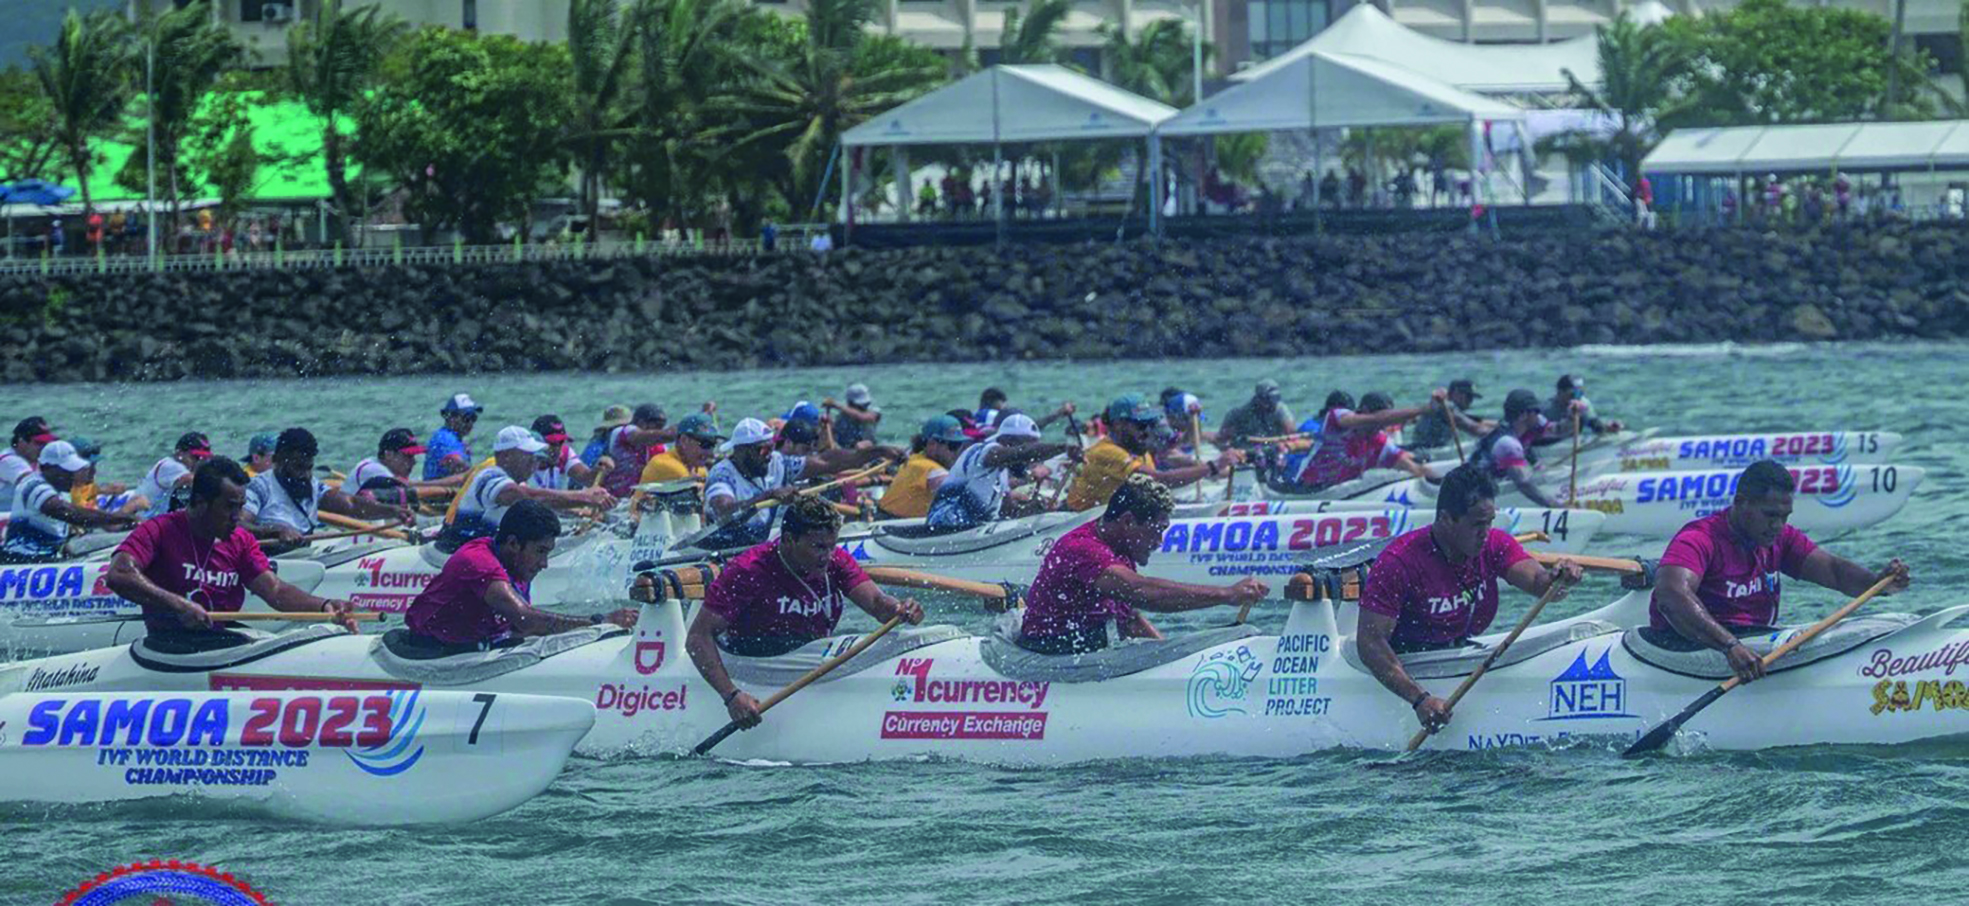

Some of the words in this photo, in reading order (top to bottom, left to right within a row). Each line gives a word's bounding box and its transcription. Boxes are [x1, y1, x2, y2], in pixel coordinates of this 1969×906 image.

[1678, 439, 1766, 459] SAMOA
[1772, 434, 1834, 456] 2023
[1858, 434, 1879, 453] 15
[1871, 467, 1898, 493] 10
[1161, 520, 1279, 553] AMOA
[1288, 516, 1392, 550] 2023
[1540, 511, 1569, 541] 14
[380, 572, 434, 588] curre
[1209, 564, 1303, 576] CHAMPIONSH
[0, 566, 84, 600] MOA
[1277, 634, 1330, 654] PACIFIC
[1272, 656, 1319, 674] OCEAN
[1857, 639, 1969, 678] Beautif
[1269, 677, 1318, 695] LITTER
[1554, 682, 1622, 713] NEH
[1869, 679, 1969, 716] SAMO
[596, 684, 687, 717] Digicel
[1265, 698, 1332, 716] PROJECT
[22, 699, 229, 746] SAMOA
[240, 696, 394, 748] 2023
[468, 693, 498, 745] 7
[885, 714, 958, 735] Currency
[963, 714, 1043, 737] Exchange
[98, 749, 132, 765] IVF
[135, 749, 208, 766] WORLD
[210, 751, 310, 768] DISTANCE
[125, 768, 277, 786] CHAMPIONSHIP
